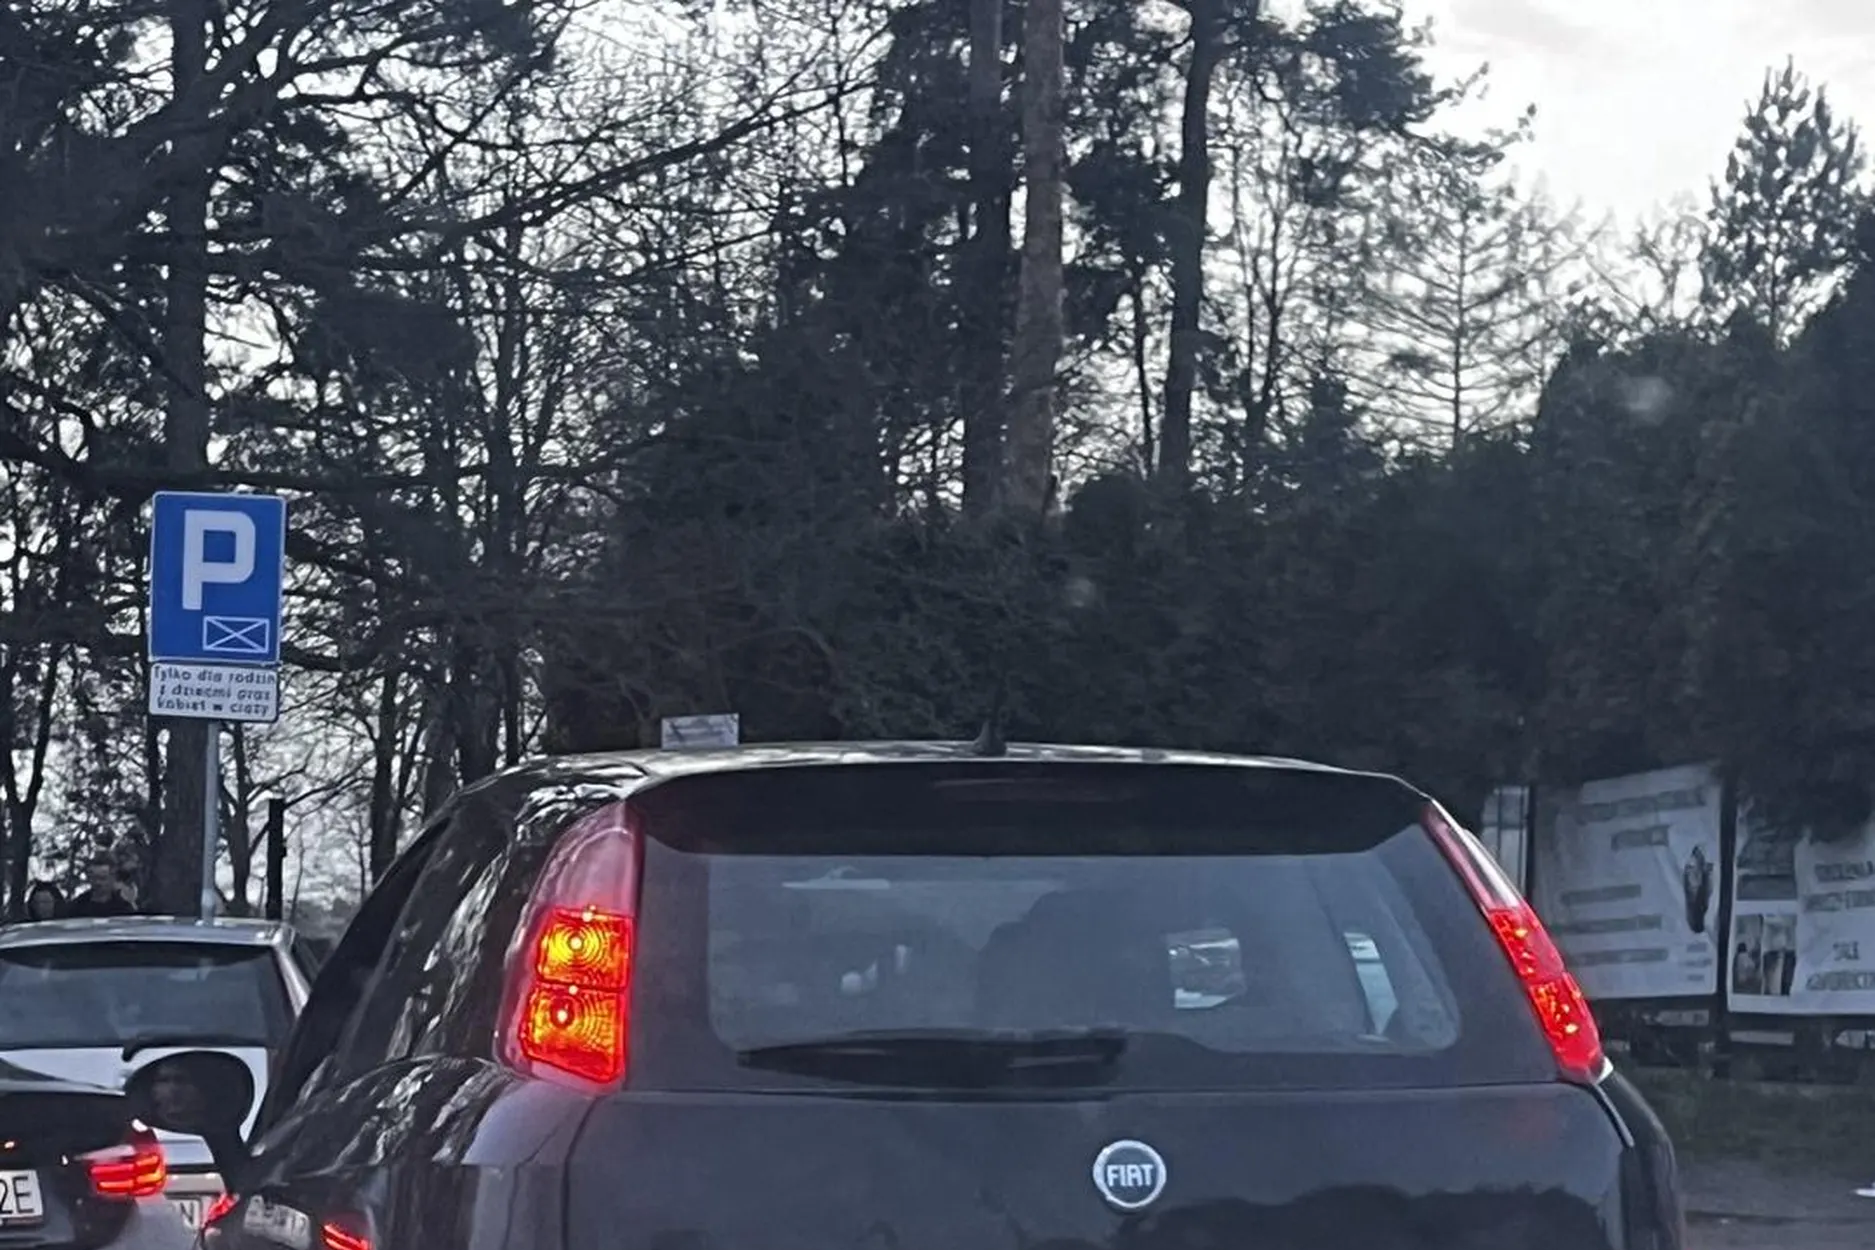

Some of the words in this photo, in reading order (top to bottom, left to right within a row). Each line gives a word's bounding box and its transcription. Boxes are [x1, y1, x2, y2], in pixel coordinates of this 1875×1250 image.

[182, 509, 256, 610] P
[154, 666, 192, 681] Tylko
[198, 669, 222, 682] dla
[229, 672, 276, 685] rodzin
[156, 696, 206, 711] kobiet
[212, 703, 223, 712] w
[237, 689, 270, 701] oraz
[1107, 1164, 1154, 1187] FIAT
